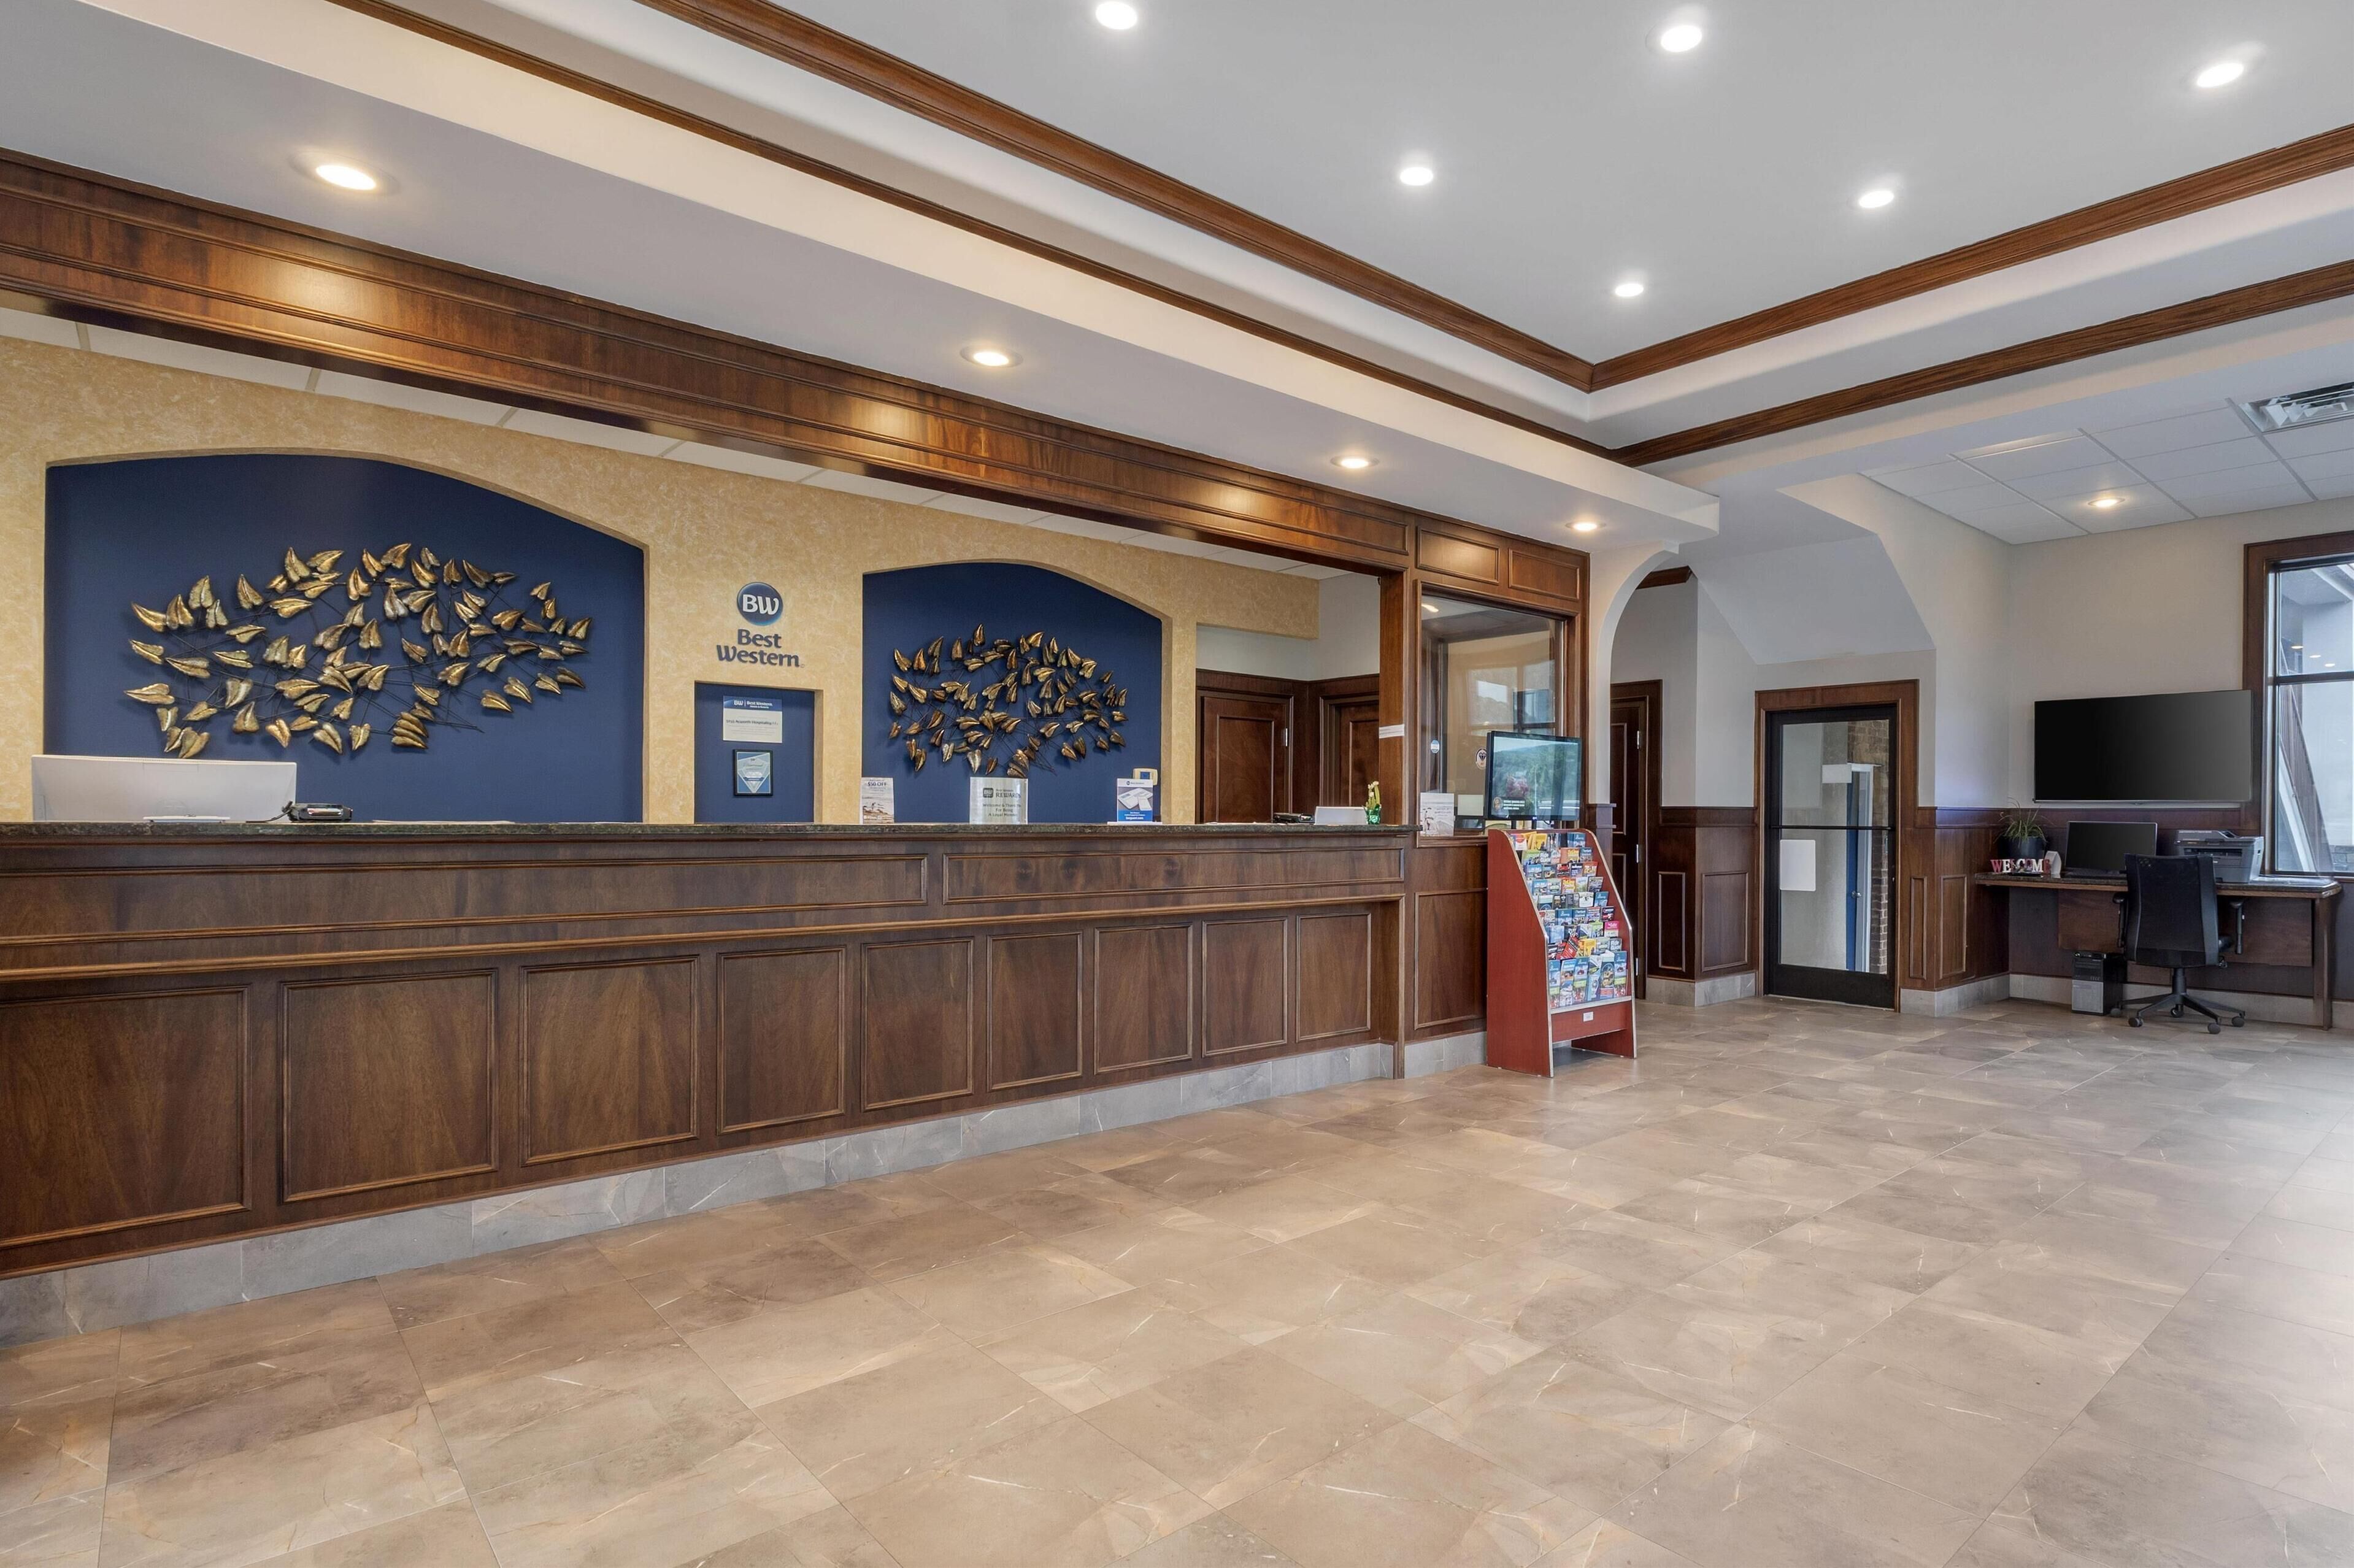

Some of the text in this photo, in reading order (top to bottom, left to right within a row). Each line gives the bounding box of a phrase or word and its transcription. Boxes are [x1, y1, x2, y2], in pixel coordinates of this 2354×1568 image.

[742, 594, 779, 615] BW
[737, 629, 782, 648] Best
[716, 645, 799, 667] Western
[1990, 858, 2052, 874] WELCOME
